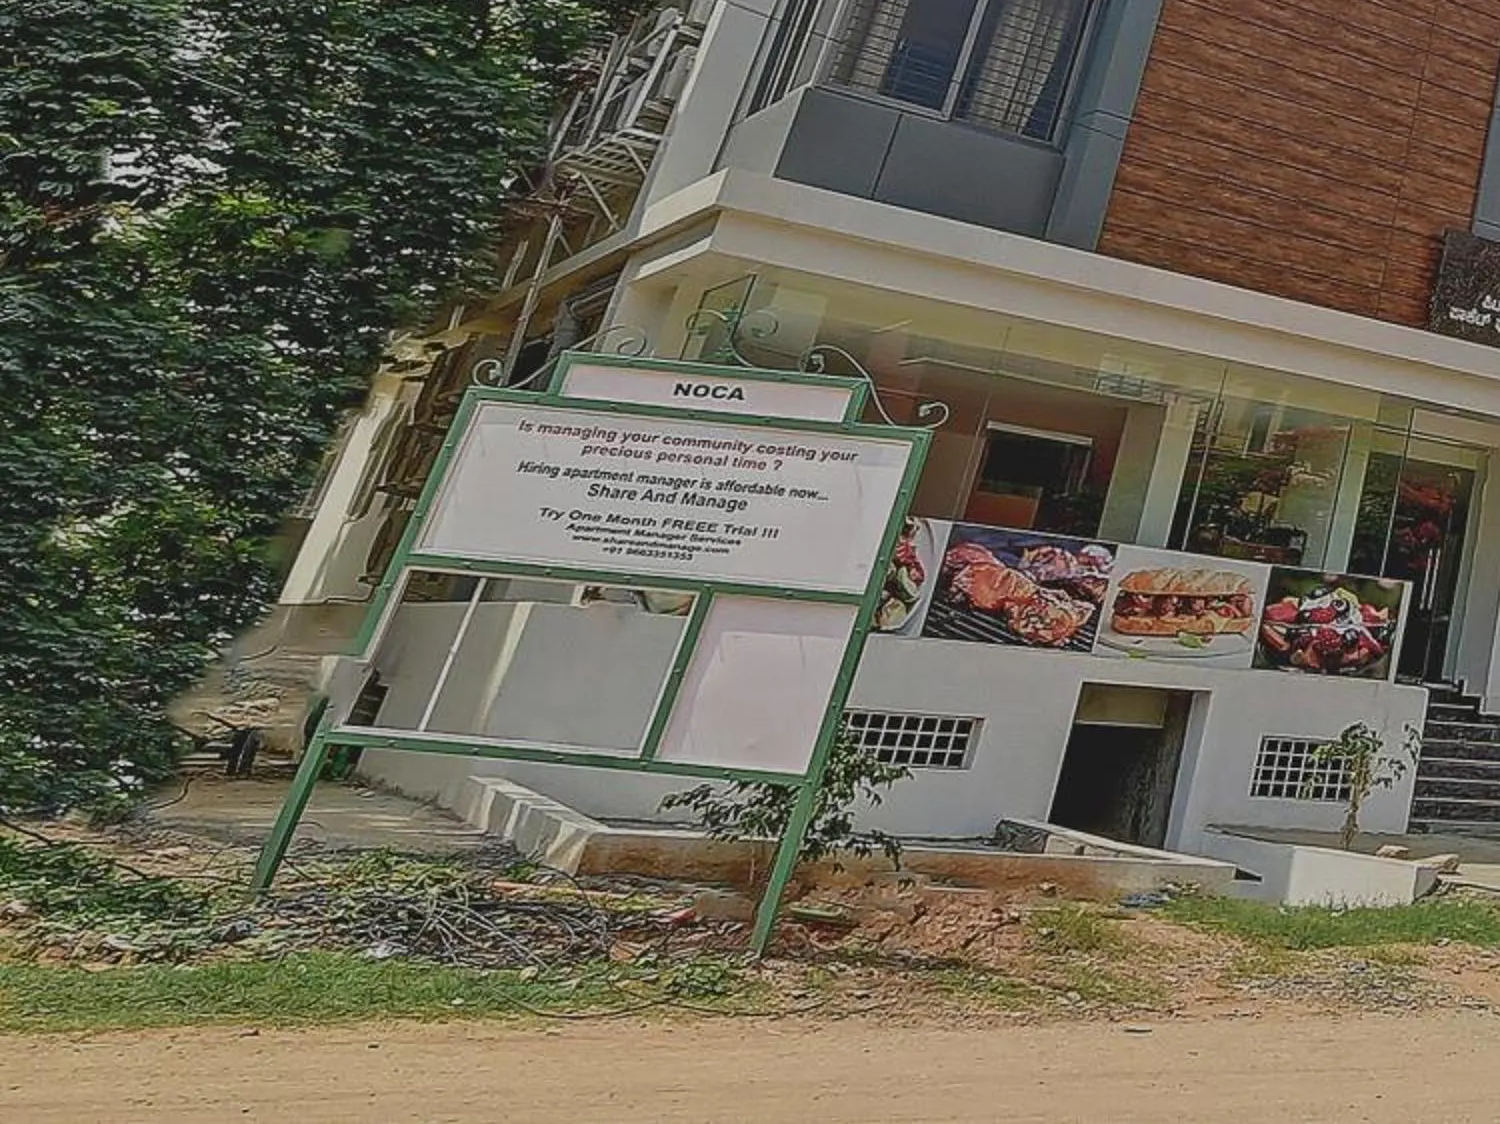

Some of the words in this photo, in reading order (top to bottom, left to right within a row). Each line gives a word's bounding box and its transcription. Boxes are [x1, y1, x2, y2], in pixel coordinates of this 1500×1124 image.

[673, 382, 745, 401] NOCA
[518, 419, 533, 432] Is
[537, 423, 618, 443] managing
[620, 431, 661, 444] your
[661, 435, 753, 454] community
[756, 442, 817, 462] costing
[818, 451, 859, 463] your
[580, 444, 653, 460] precious
[655, 450, 728, 467] personal
[731, 457, 767, 470] time
[773, 459, 784, 471] ?
[516, 460, 561, 478] Hiring
[563, 467, 635, 484] apartment
[635, 475, 699, 490] manager
[699, 477, 713, 490] is
[715, 479, 786, 497] affordable
[587, 483, 638, 501] Share
[640, 489, 678, 504] And
[680, 491, 748, 513] Manage
[539, 507, 565, 521] Try
[568, 509, 602, 522] One
[605, 513, 657, 527] Month
[722, 523, 759, 536] Trial
[564, 523, 632, 536] Apartment
[634, 529, 688, 541] Manager
[689, 534, 741, 545] Services
